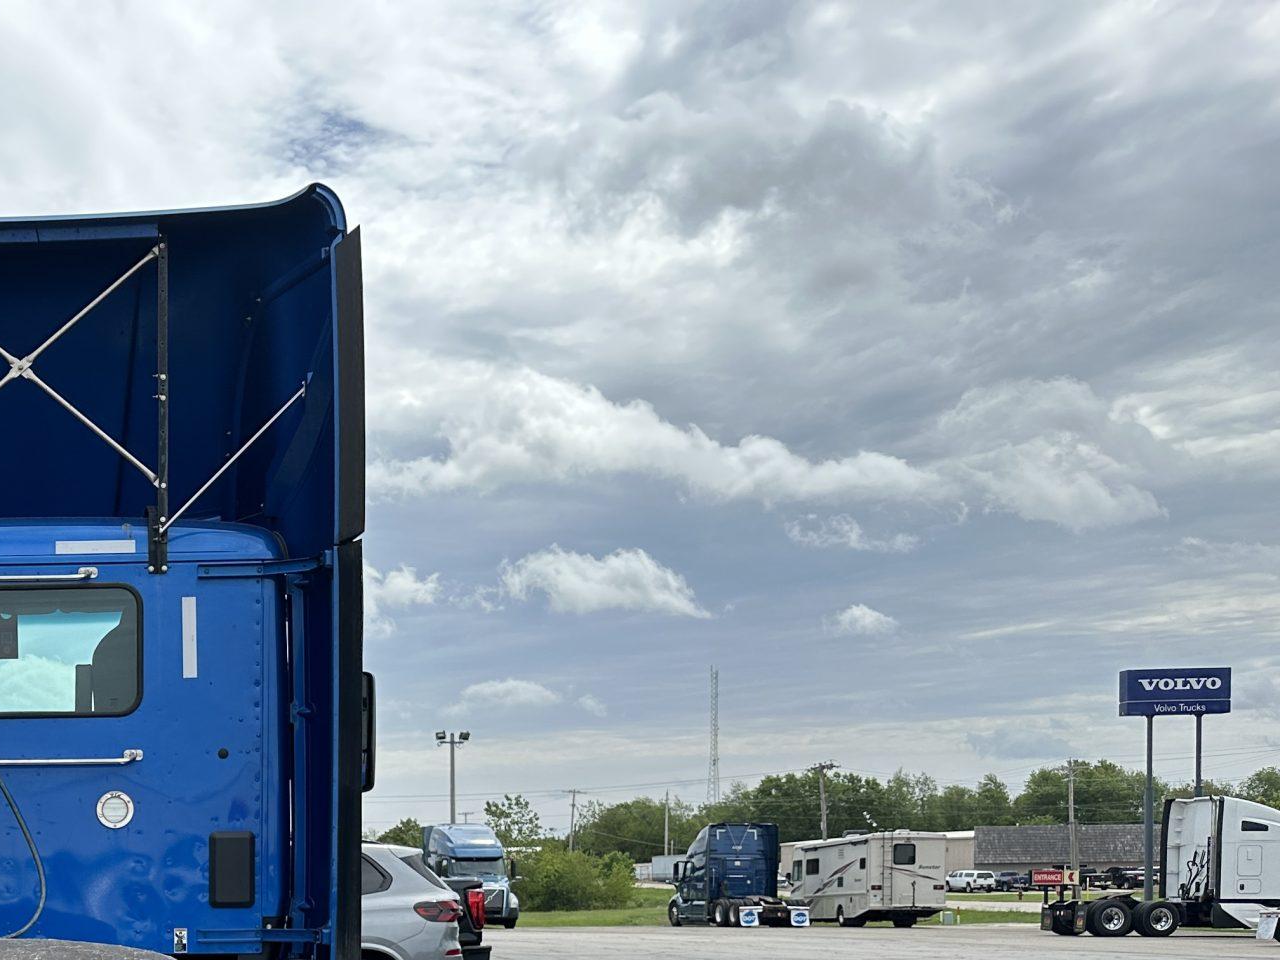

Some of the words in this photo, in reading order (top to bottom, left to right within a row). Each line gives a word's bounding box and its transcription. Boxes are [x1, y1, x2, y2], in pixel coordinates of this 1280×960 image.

[1138, 677, 1222, 691] VOLVO
[1154, 703, 1177, 712] Volvo
[1179, 703, 1206, 712] Trucks
[1034, 873, 1062, 881] ENTRANCE
